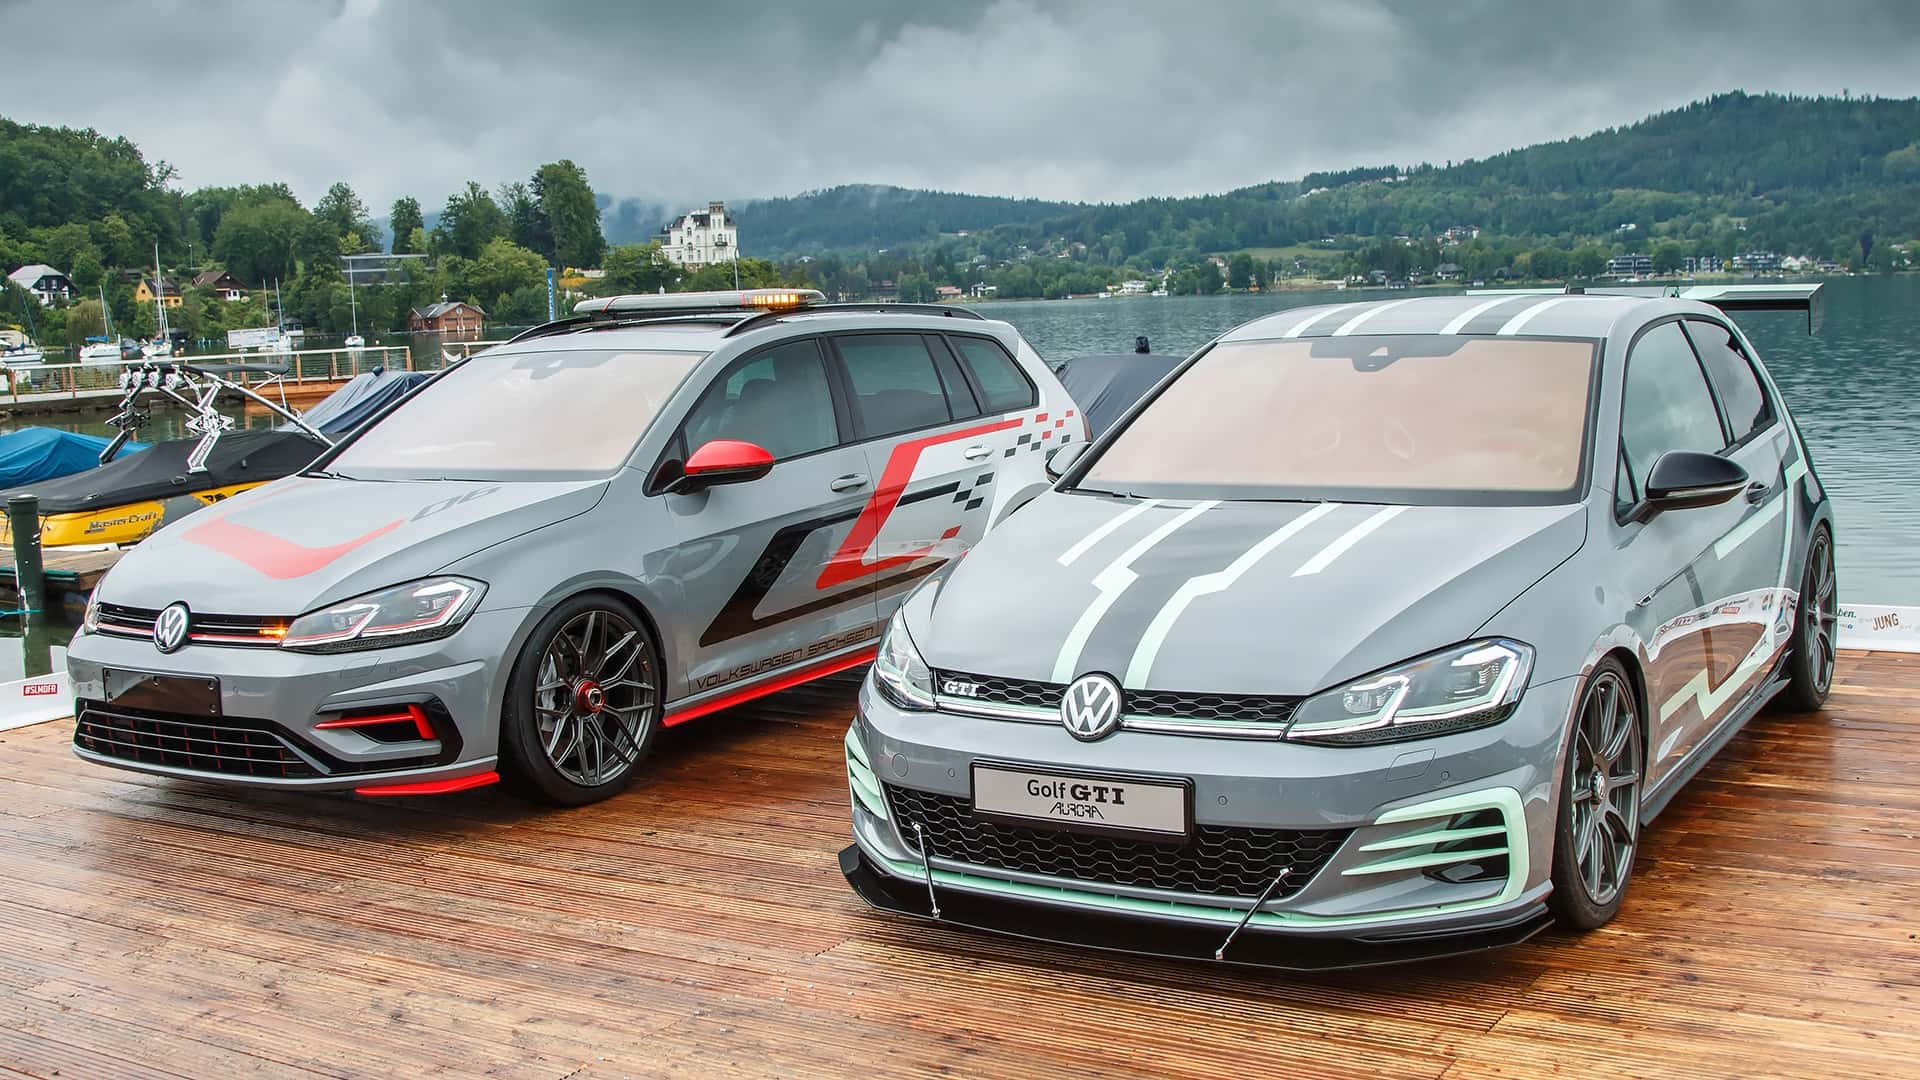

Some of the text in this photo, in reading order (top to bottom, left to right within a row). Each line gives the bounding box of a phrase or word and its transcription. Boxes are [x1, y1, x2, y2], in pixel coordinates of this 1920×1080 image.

[1837, 607, 1857, 618] ben.
[1872, 613, 1899, 631] JUNG
[695, 625, 875, 689] VOLKSWAGEN SACHSEN
[943, 681, 980, 698] GTI
[1027, 779, 1125, 805] Golf GTI
[1049, 801, 1105, 820] AURORA
